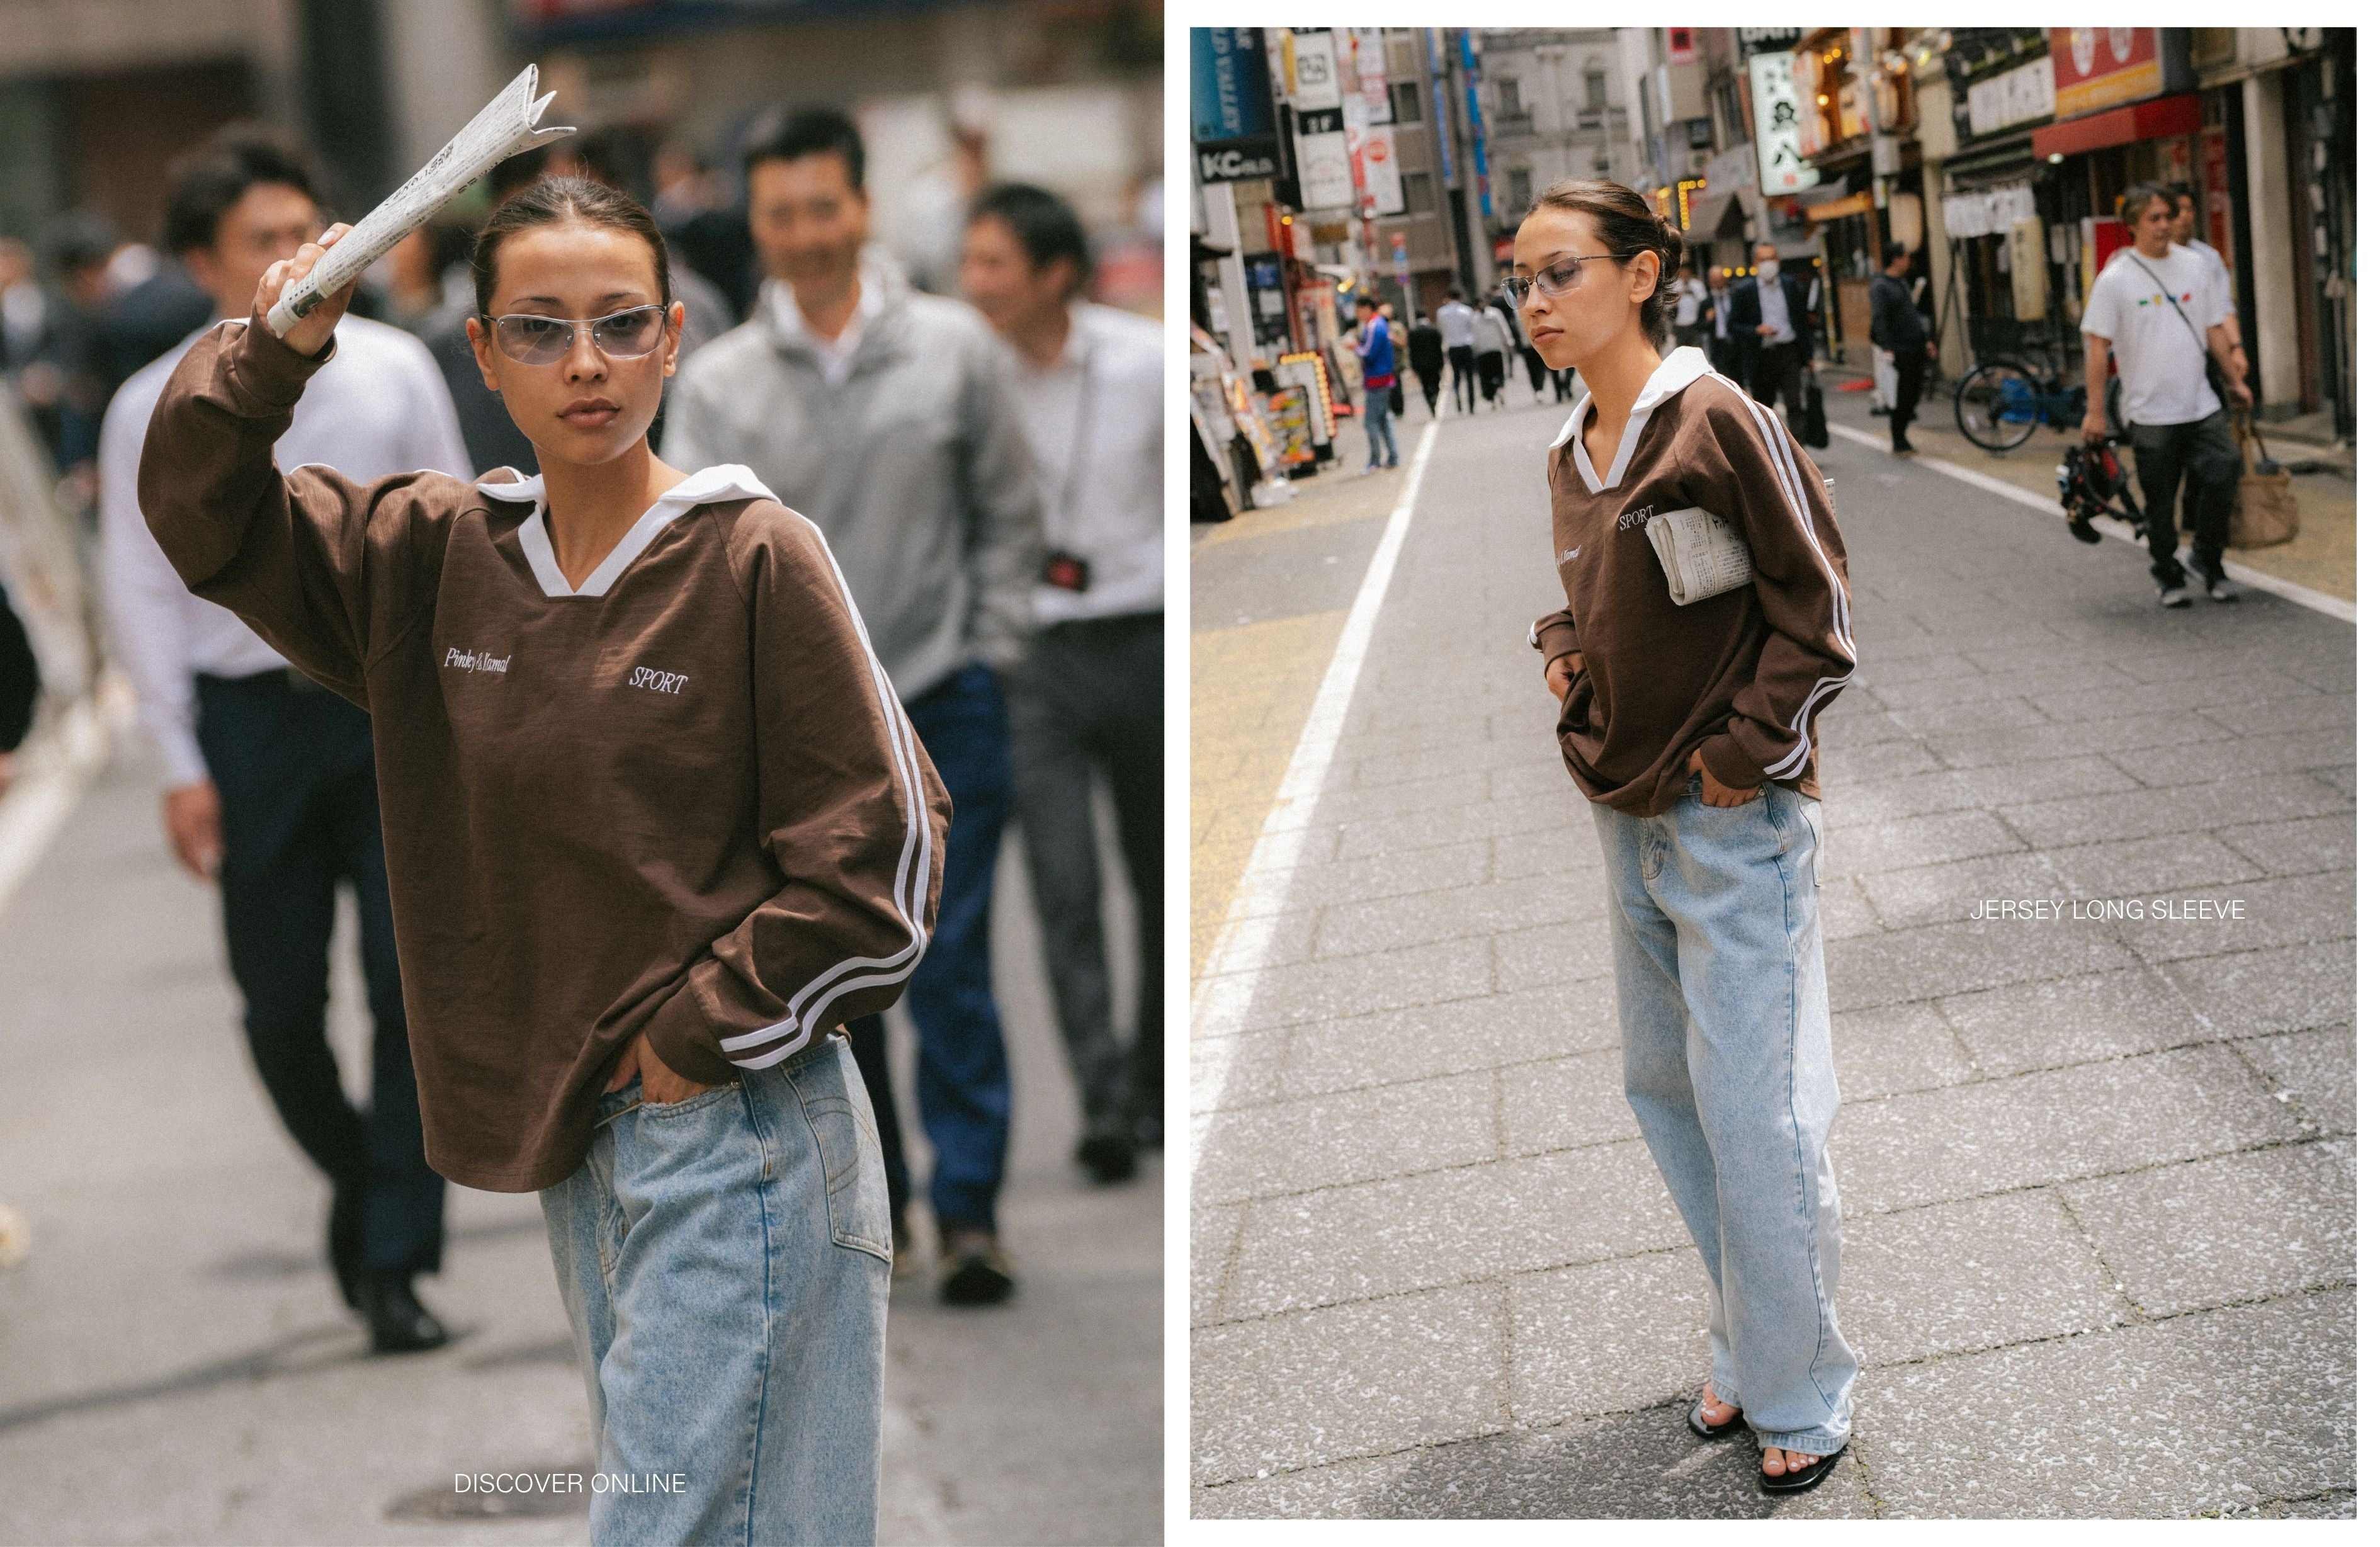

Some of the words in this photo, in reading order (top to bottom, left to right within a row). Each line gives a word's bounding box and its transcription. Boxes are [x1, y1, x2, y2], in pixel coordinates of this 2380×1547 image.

[1619, 504, 1654, 531] SPORT
[444, 647, 476, 674] Pinky
[476, 652, 483, 671] &
[482, 652, 511, 673] Kamal
[629, 666, 688, 694] SPORT
